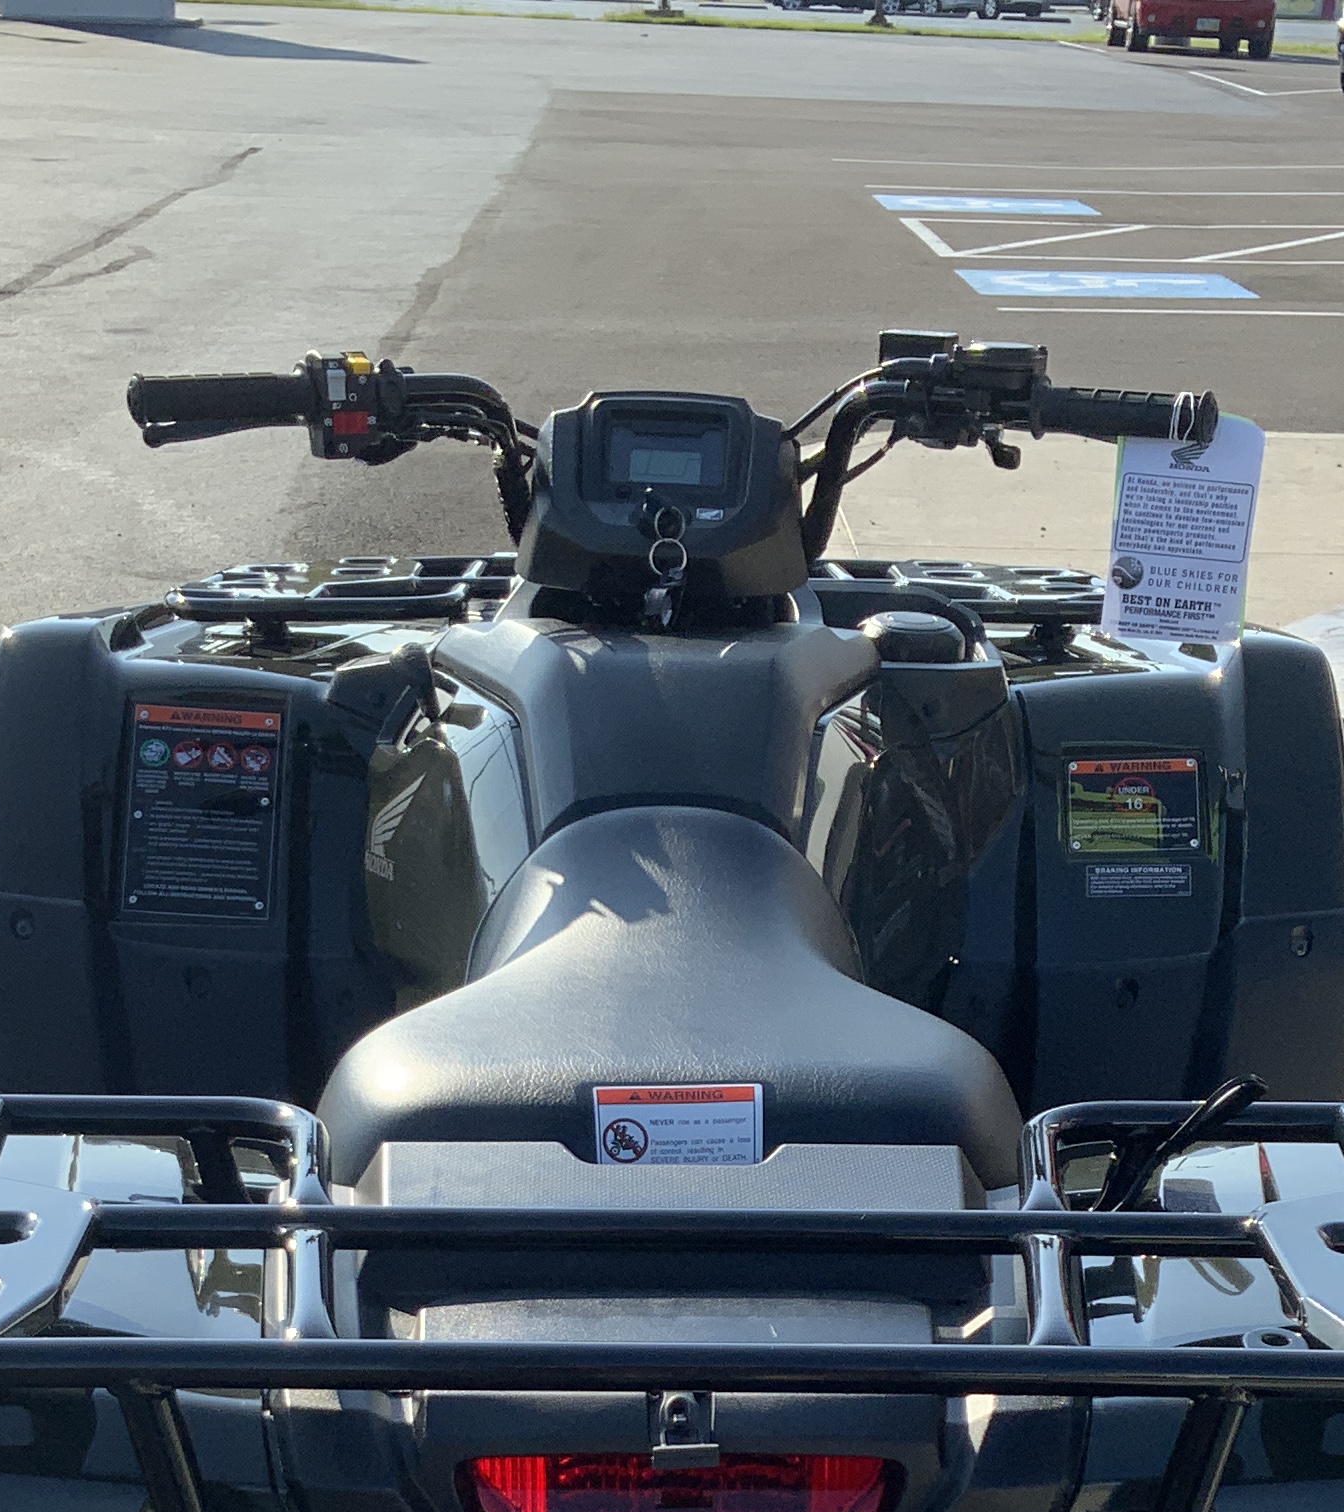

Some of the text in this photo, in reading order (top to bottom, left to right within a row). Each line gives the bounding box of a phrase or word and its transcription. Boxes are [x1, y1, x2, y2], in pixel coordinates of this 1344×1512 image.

[1169, 462, 1210, 472] HONDA
[1150, 566, 1238, 583] BLUE SKIES FOR
[1148, 578, 1238, 595] OUR CHILDREN
[1122, 594, 1152, 606] BEST
[1155, 597, 1171, 608] ON
[1124, 605, 1182, 619] PERFORMANCE
[181, 711, 242, 724] WARNING
[1110, 761, 1171, 772] WARNING
[1118, 786, 1149, 794] UNDER
[1126, 798, 1143, 810] 16
[364, 850, 394, 881] HONDA
[649, 1089, 724, 1101] WARNING
[651, 1139, 687, 1147] Passengers
[651, 1156, 679, 1164] SEVERE
